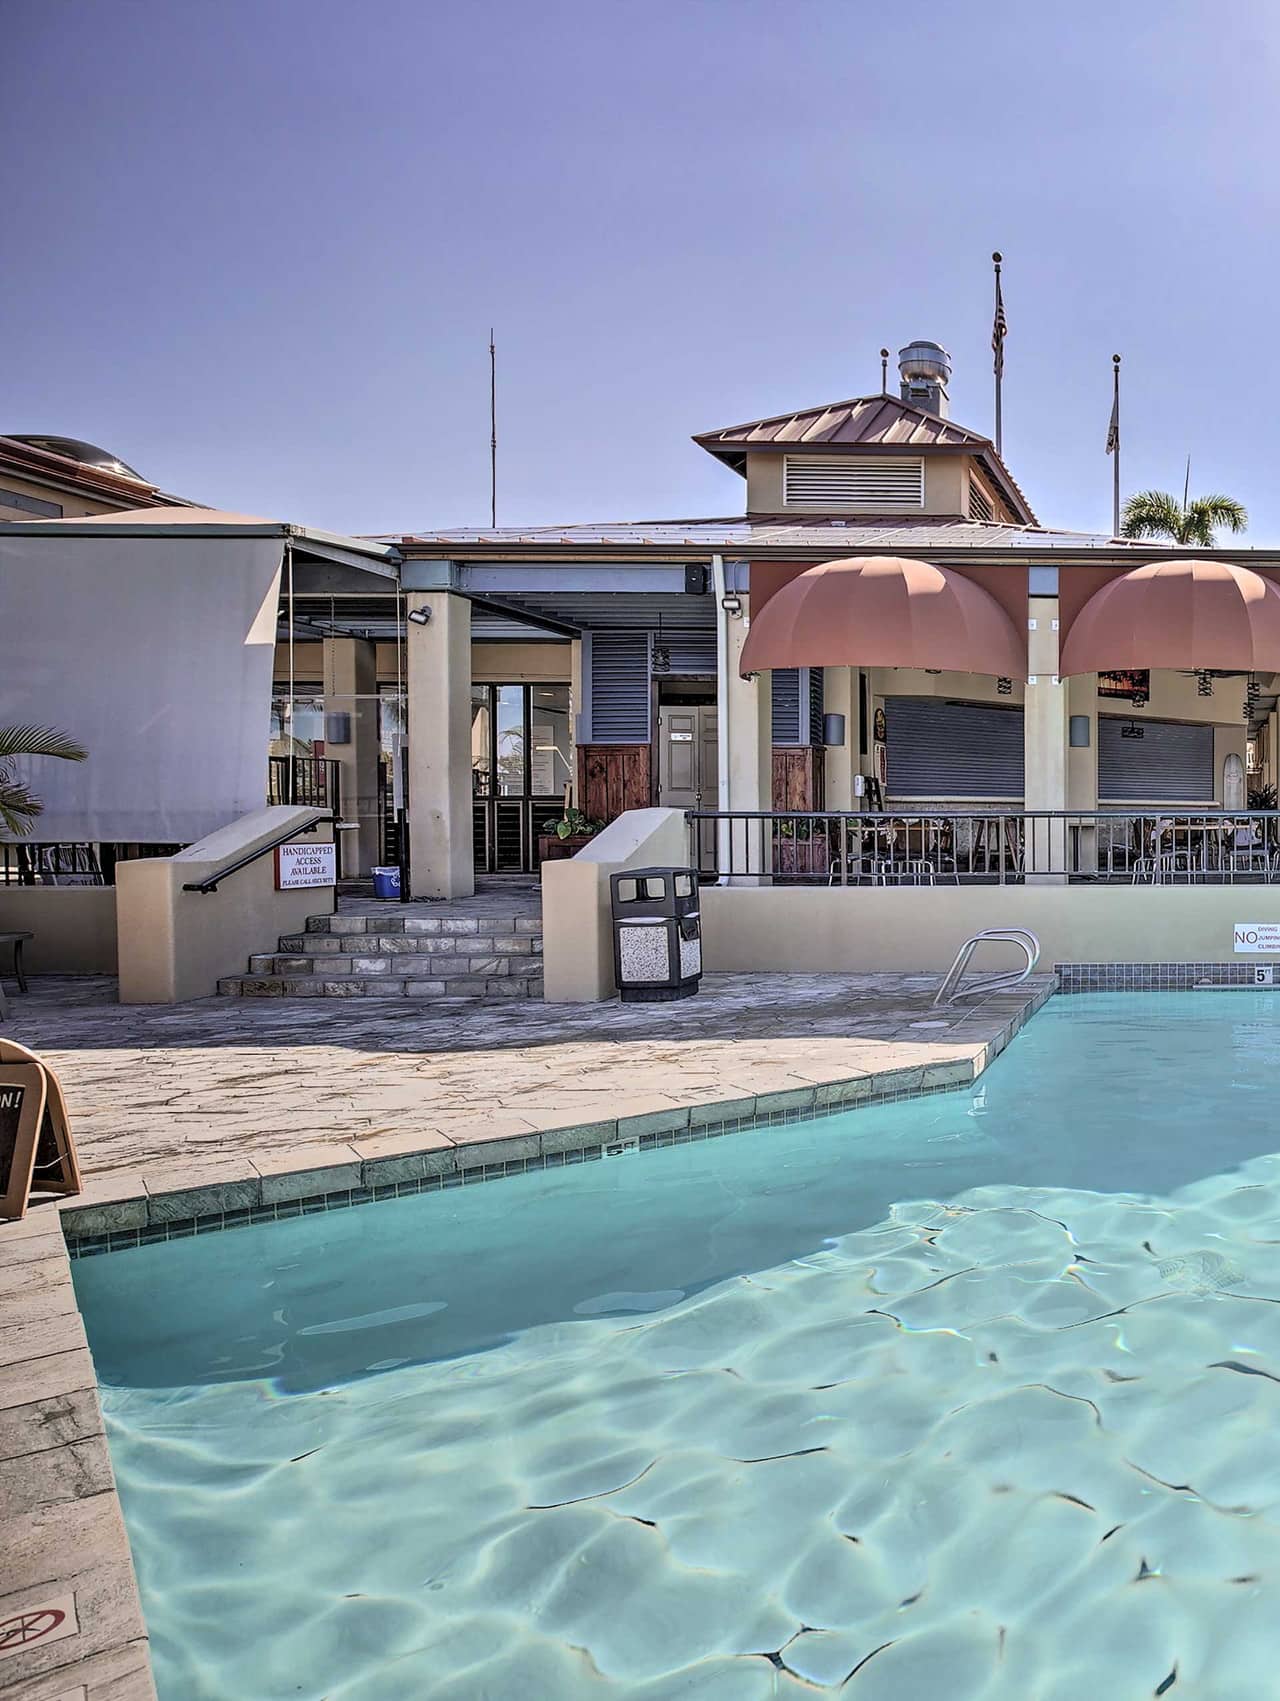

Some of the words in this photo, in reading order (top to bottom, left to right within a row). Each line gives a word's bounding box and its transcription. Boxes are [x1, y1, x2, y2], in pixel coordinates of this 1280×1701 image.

[283, 847, 333, 856] HANDICAPPED
[295, 857, 321, 865] ACCESS
[290, 867, 327, 876] AVAILABLE
[1234, 931, 1258, 944] NO
[1257, 969, 1265, 982] 5
[0, 1091, 21, 1109] N!
